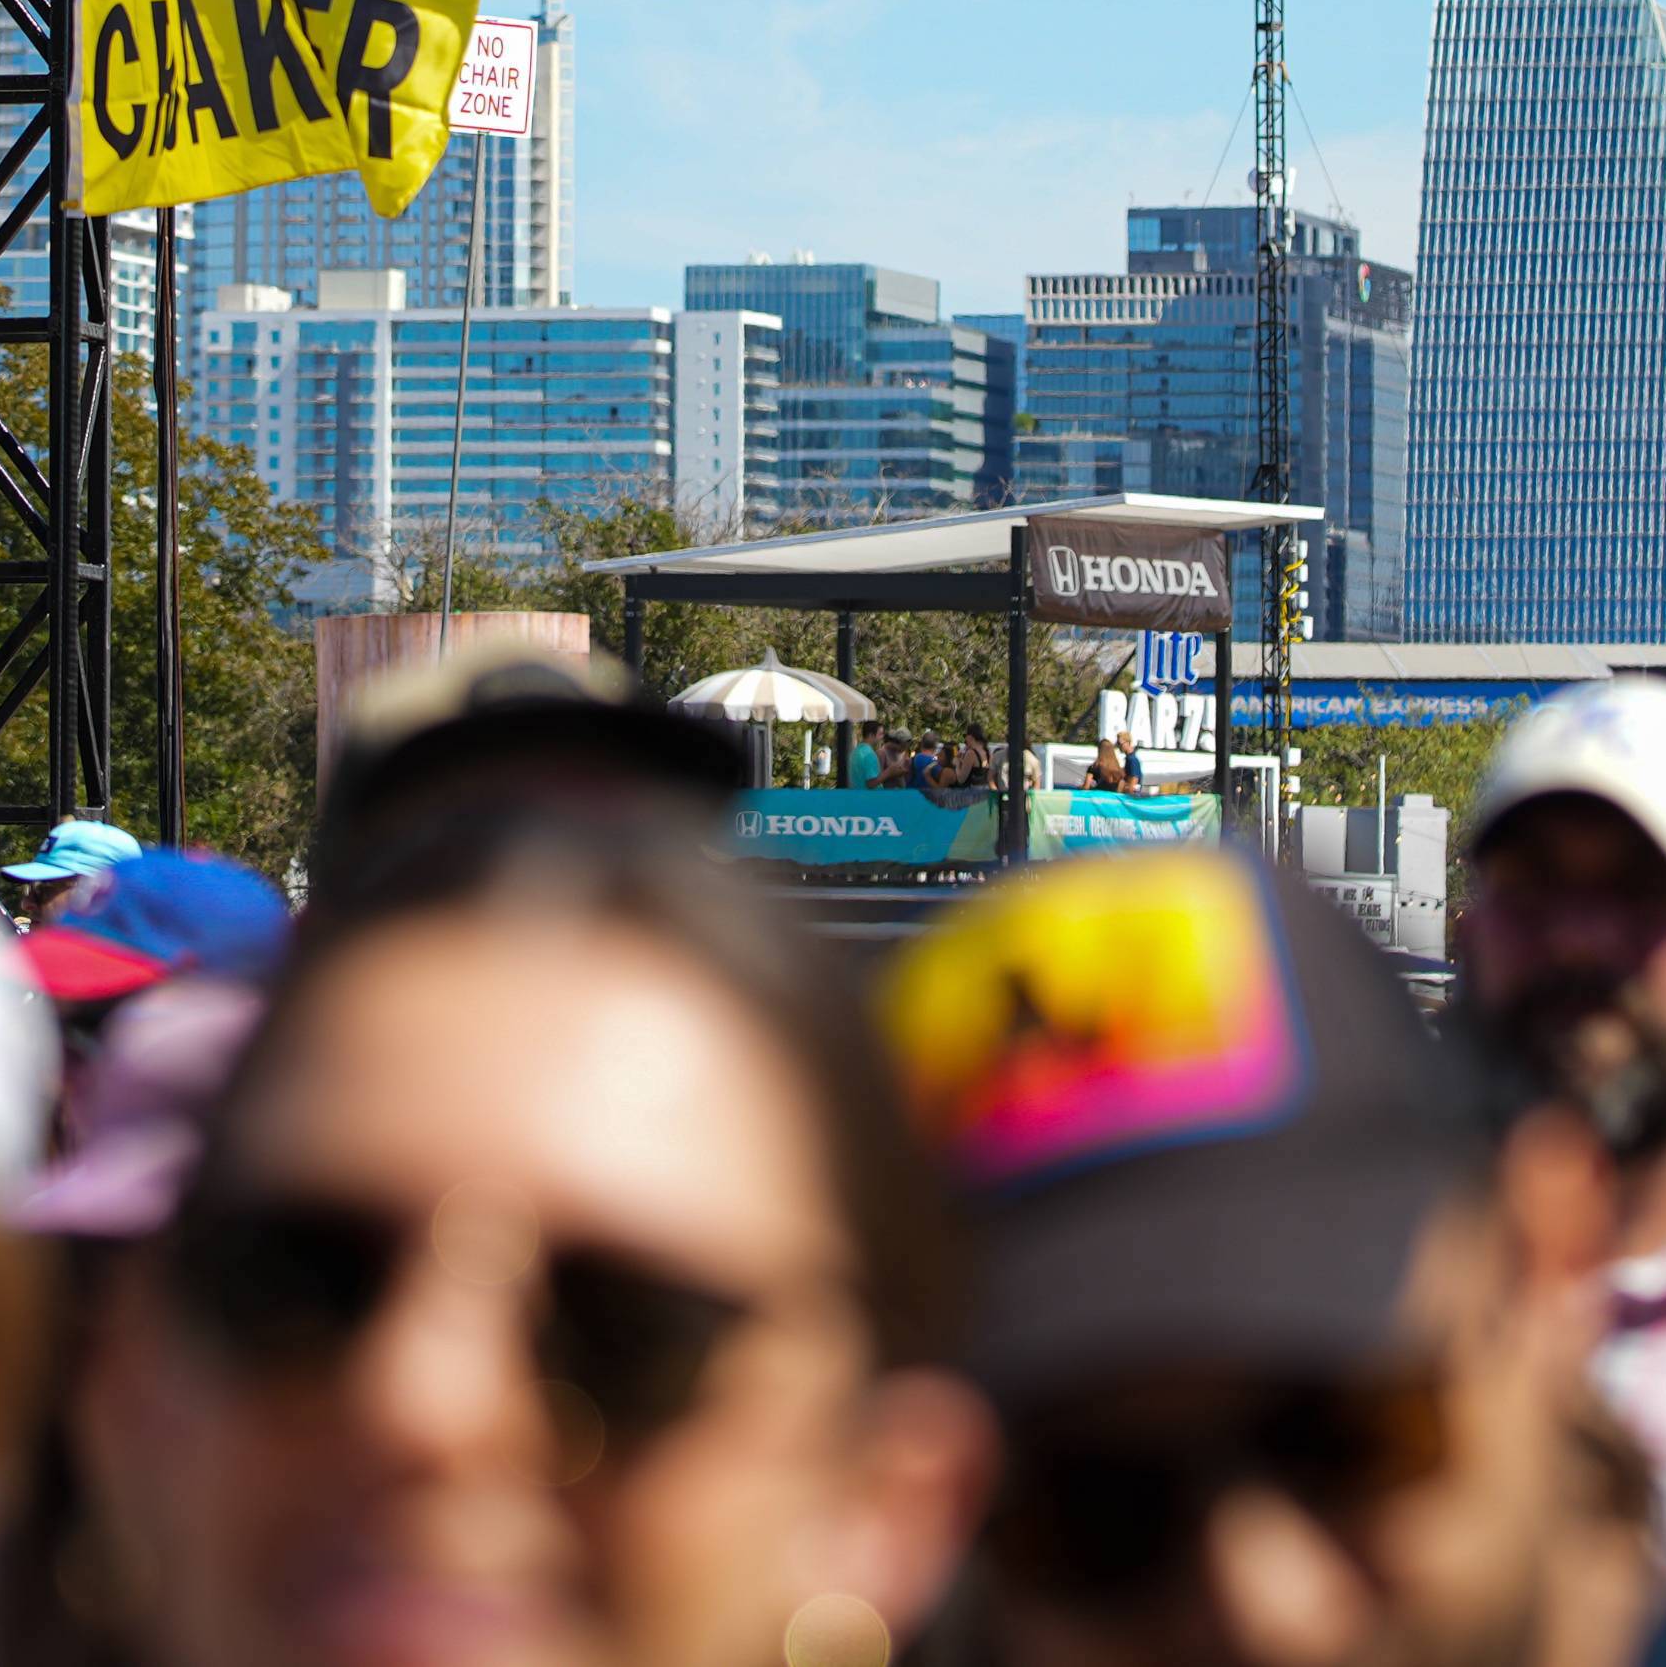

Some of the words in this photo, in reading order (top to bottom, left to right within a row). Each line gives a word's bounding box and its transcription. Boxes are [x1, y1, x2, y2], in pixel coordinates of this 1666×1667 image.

[477, 35, 504, 58] NO
[459, 62, 520, 89] CHAIR
[460, 92, 512, 118] ZONE
[1080, 554, 1219, 598] HONDA
[1138, 629, 1202, 696] Lite
[765, 815, 904, 837] HONDA
